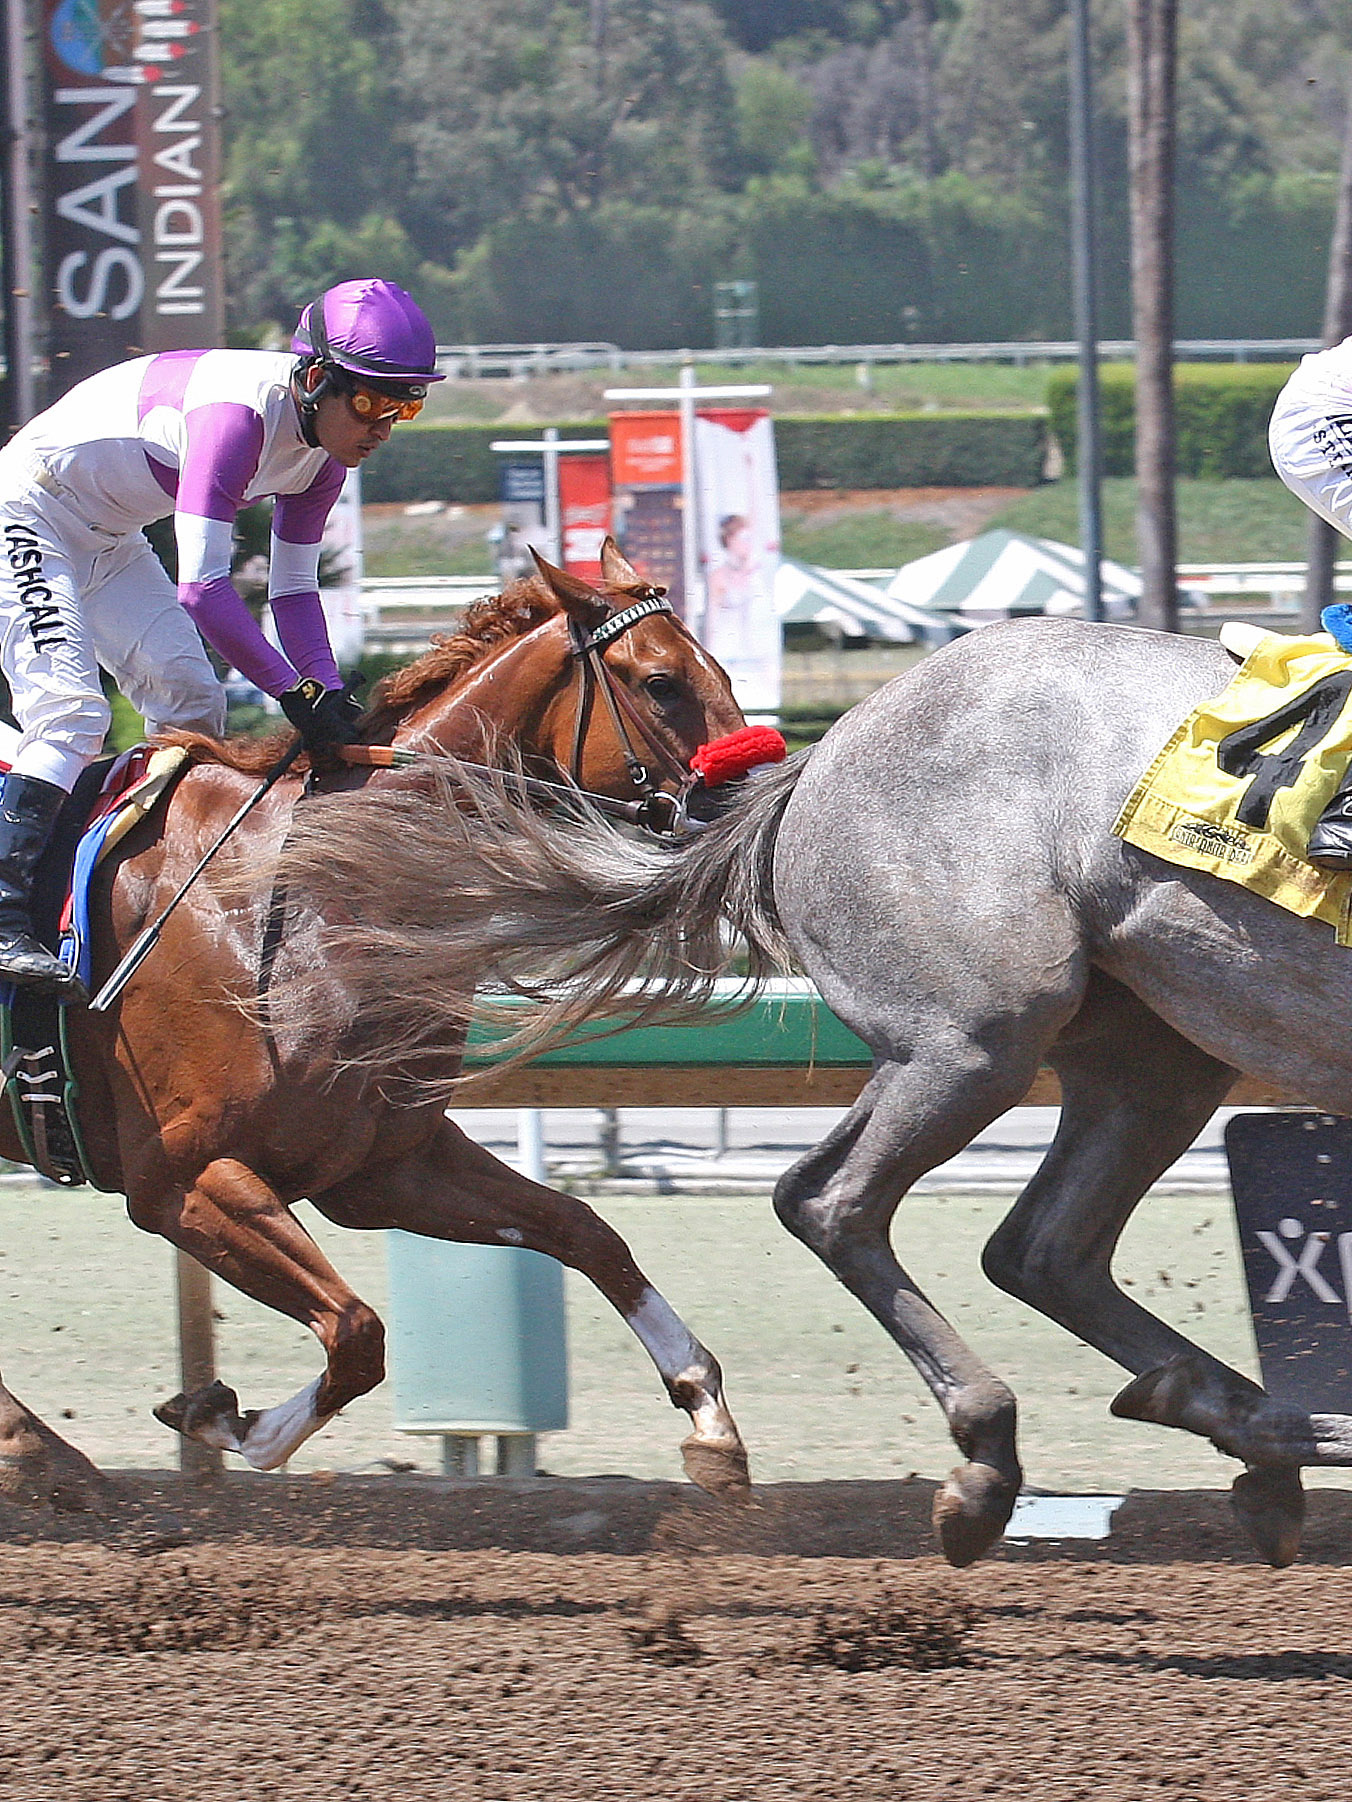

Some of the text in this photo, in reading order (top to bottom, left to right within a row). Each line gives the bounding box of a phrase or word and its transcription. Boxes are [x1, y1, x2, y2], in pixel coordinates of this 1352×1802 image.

[55, 87, 146, 321] SAN
[151, 85, 204, 315] INDIAN
[4, 524, 67, 654] CASHCALL
